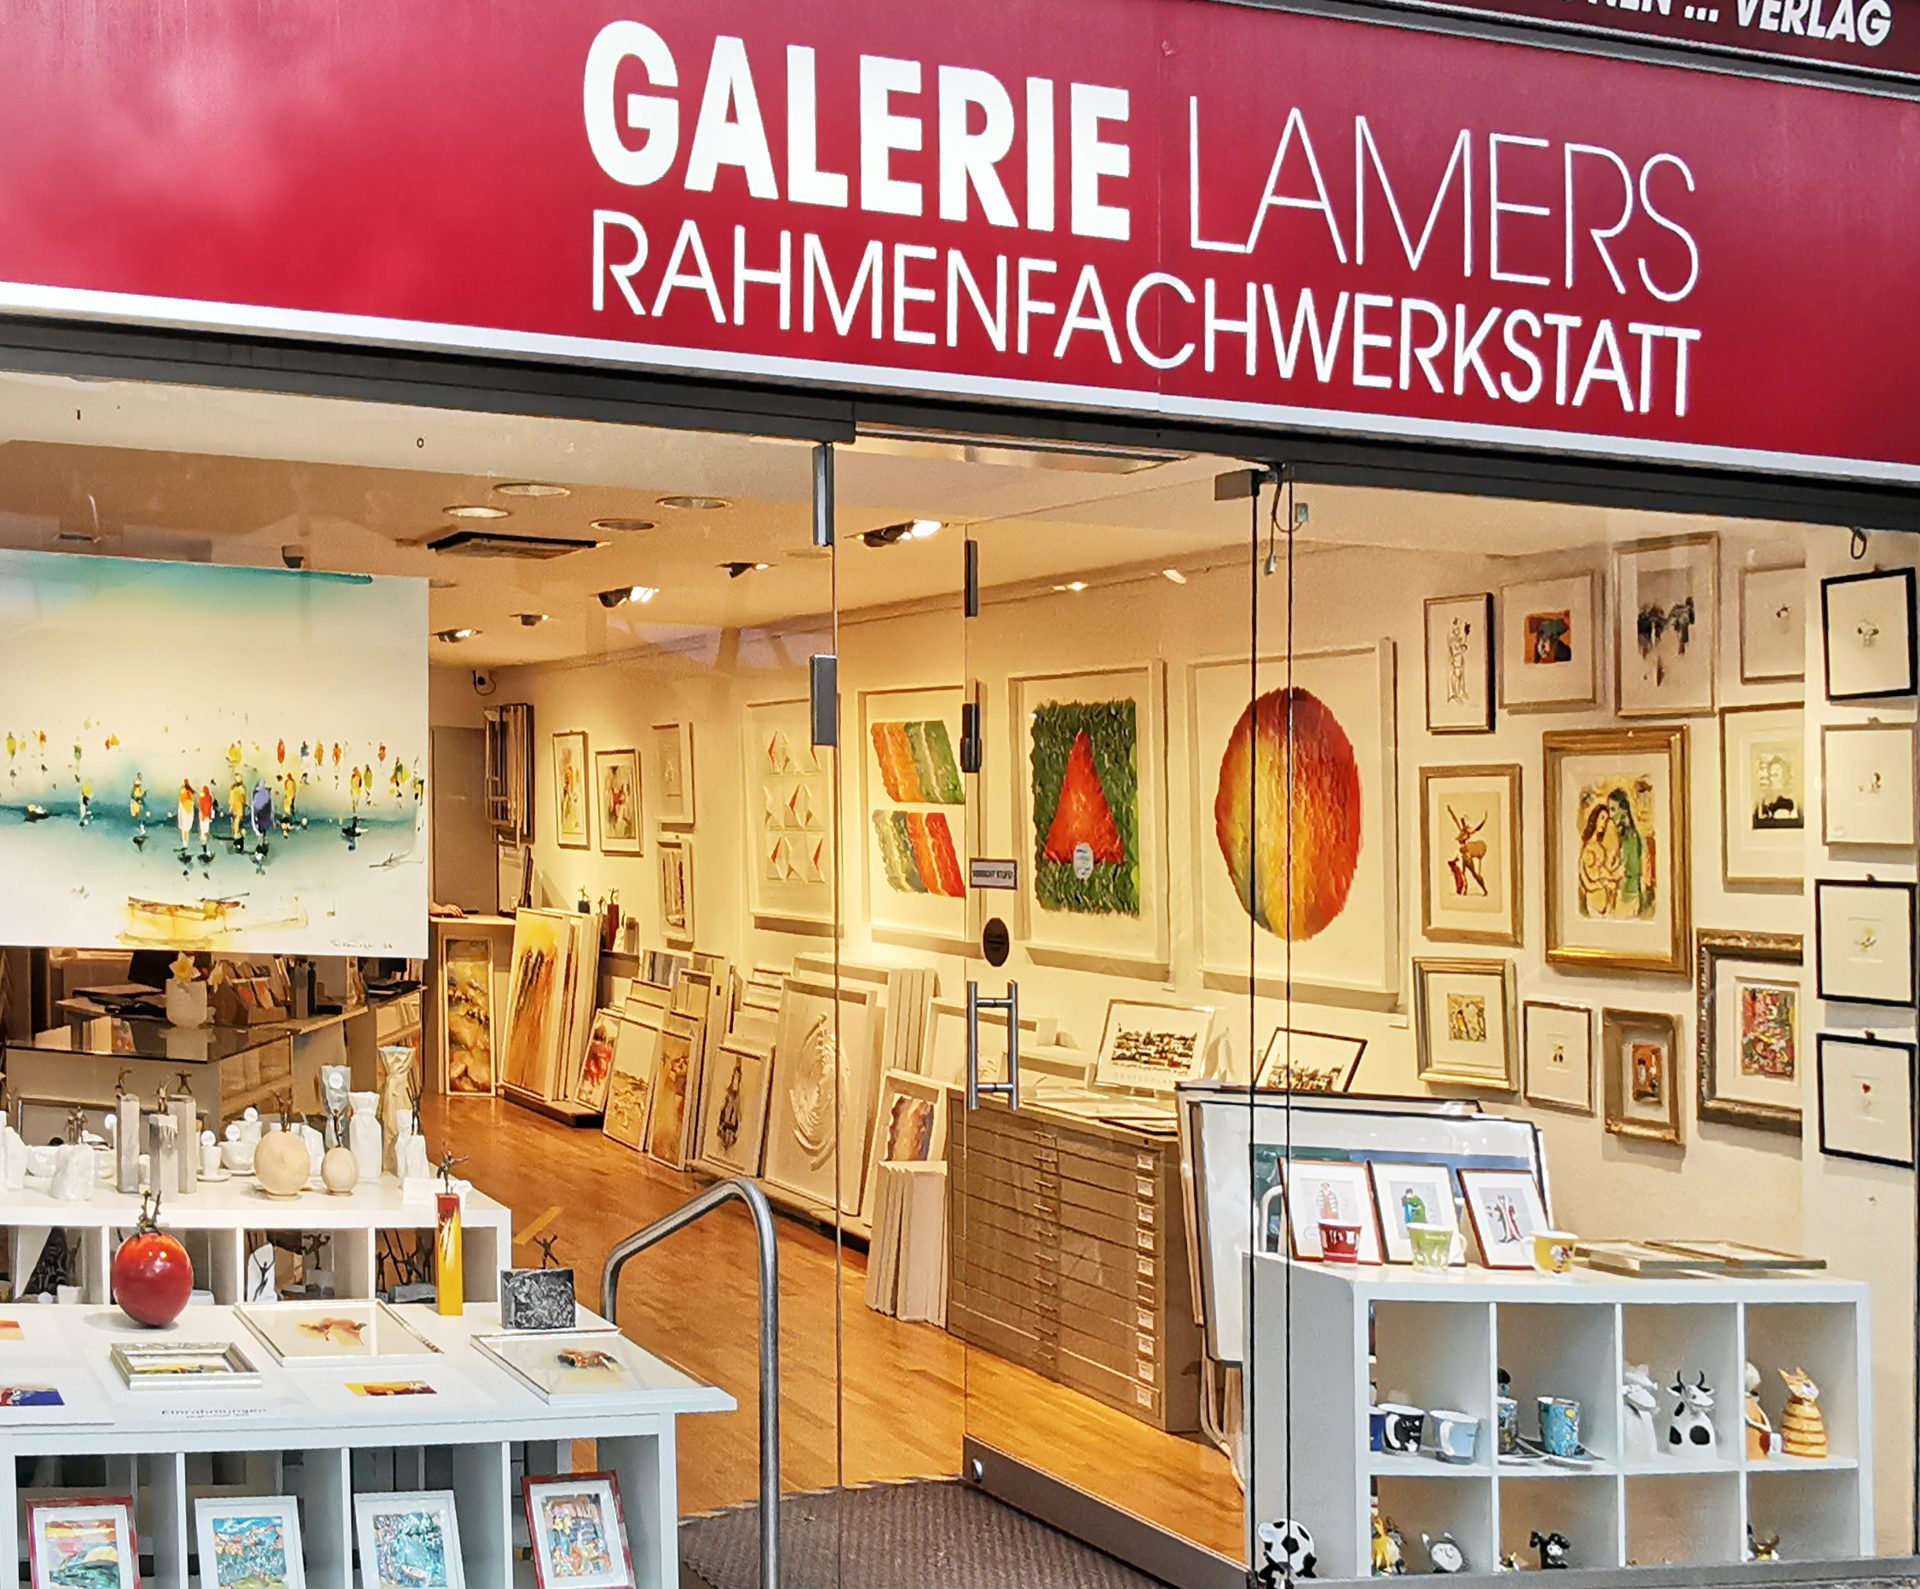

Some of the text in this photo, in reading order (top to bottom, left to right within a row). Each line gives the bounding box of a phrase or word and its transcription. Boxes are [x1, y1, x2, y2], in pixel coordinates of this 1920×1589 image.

[1735, 0, 1892, 47] VERLAG
[583, 19, 1699, 302] GALERIE LAMERS
[592, 209, 1701, 417] RAHMENFACHWERKSTATT
